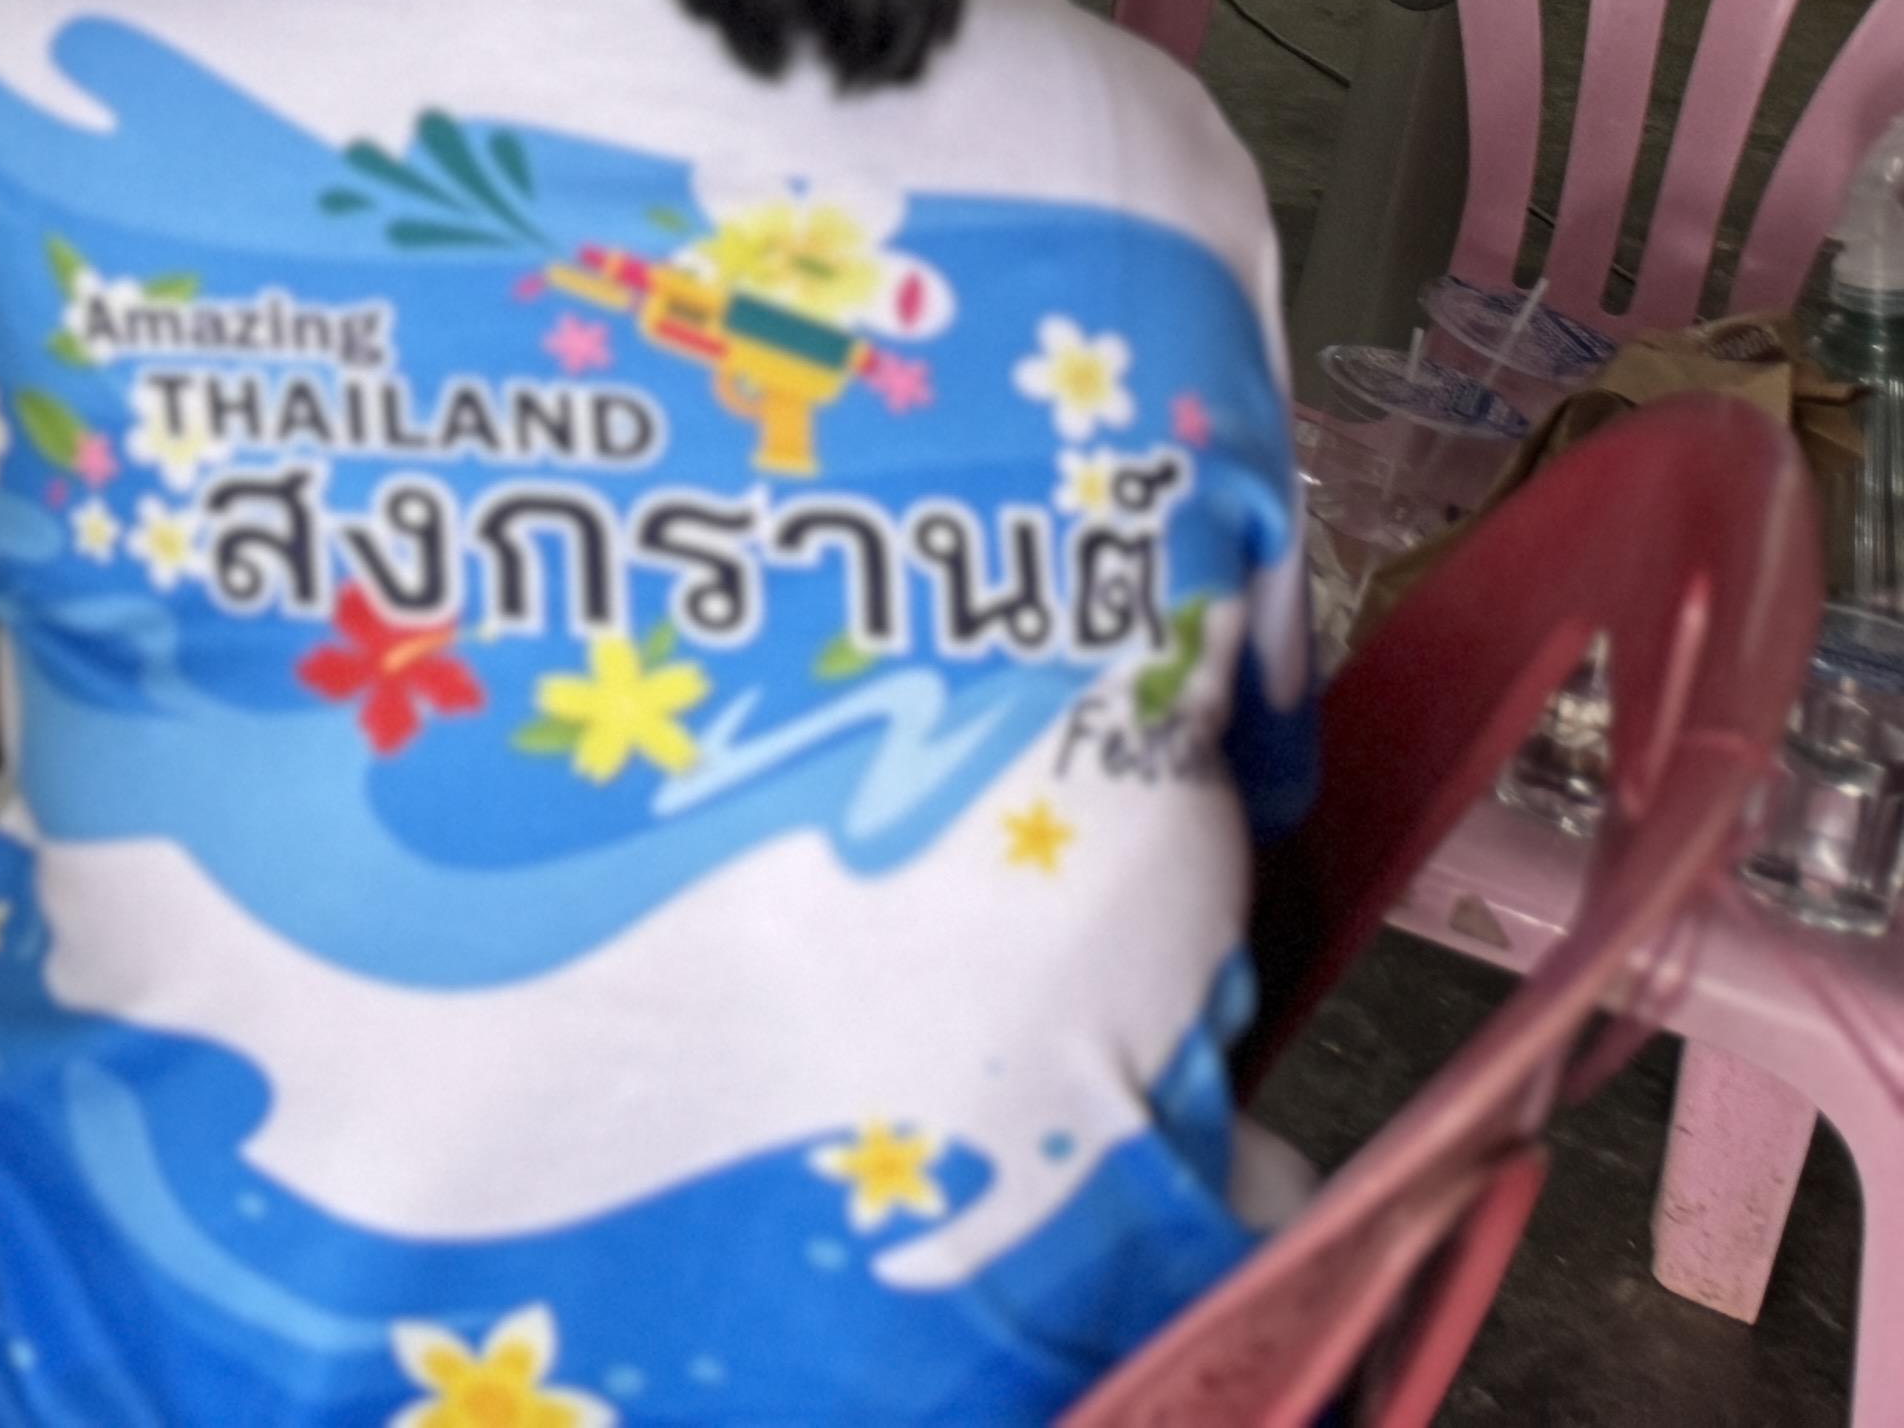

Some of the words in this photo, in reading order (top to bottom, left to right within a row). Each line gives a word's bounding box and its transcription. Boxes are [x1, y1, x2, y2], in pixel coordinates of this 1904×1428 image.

[80, 290, 387, 368] Amazing
[147, 372, 659, 462] THAILAND
[207, 456, 1179, 653] สงกรานต์
